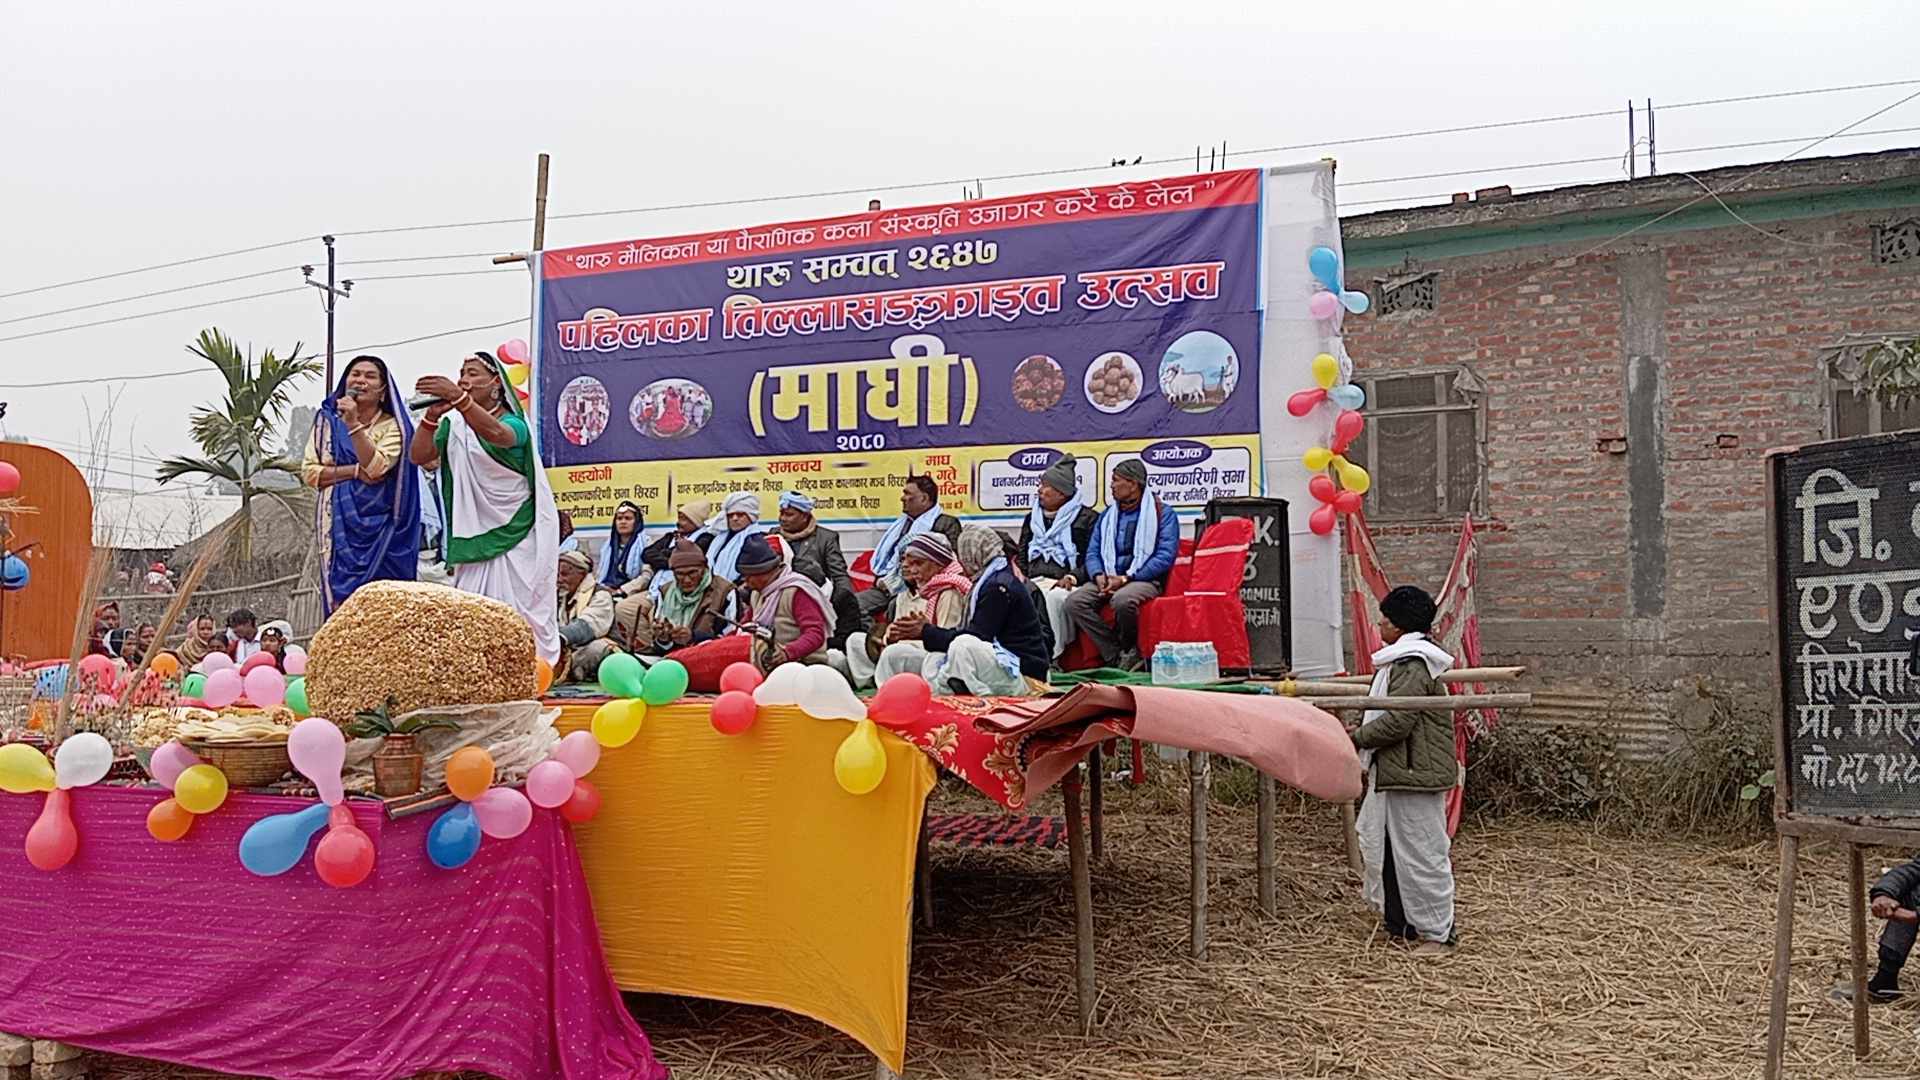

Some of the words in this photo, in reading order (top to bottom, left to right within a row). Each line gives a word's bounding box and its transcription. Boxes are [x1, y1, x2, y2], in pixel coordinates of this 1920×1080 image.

[705, 237, 730, 255] या
[822, 219, 873, 241] कला
[880, 208, 960, 235] संस्कृति
[968, 200, 1048, 223] उजागर
[1054, 189, 1101, 215] करै
[1106, 184, 1138, 210] के
[802, 248, 899, 284] सम्वत्
[907, 239, 998, 273] २६४७
[557, 307, 714, 353] पहिलका
[1076, 261, 1226, 309] उत्सव
[748, 333, 980, 437] (माघी)
[836, 433, 886, 451] २०८०
[925, 454, 951, 466] माघ
[1021, 452, 1050, 466] ठाम
[1151, 445, 1204, 461] आयोजक
[567, 465, 613, 484] सहयोगी
[767, 459, 823, 475] समन्वय
[936, 465, 957, 481] गते
[762, 477, 783, 492] सिरहा
[1147, 466, 1218, 487] ल्याणकारिणी
[1221, 469, 1246, 485] सभा
[633, 483, 659, 499] सिरहा
[860, 495, 881, 509] सिरहा
[1004, 492, 1030, 507] आम
